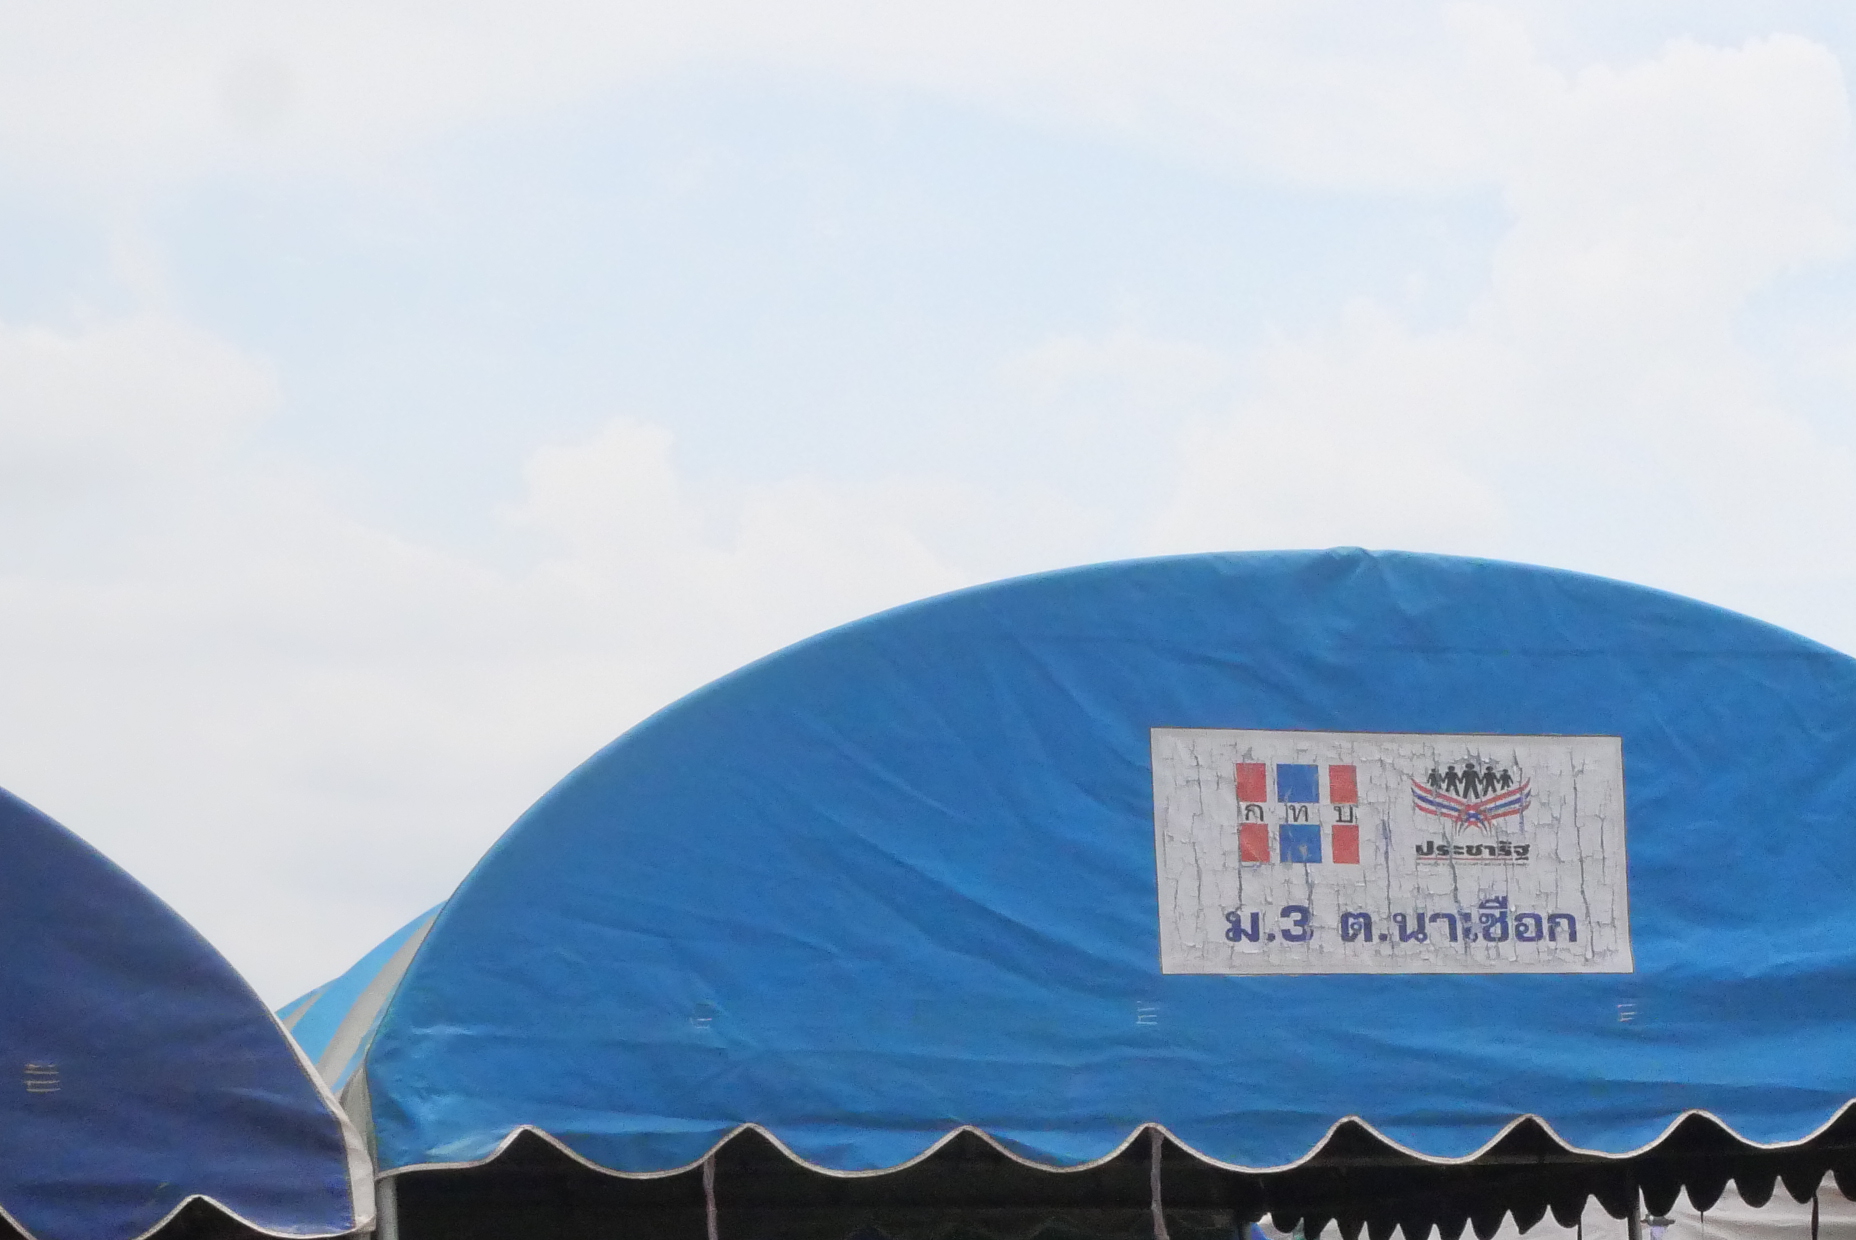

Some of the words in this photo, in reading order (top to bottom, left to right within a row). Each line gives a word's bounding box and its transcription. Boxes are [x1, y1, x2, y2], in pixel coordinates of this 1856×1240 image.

[1225, 904, 1314, 943] ม.3
[1340, 895, 1578, 943] ต.นาเชือก
